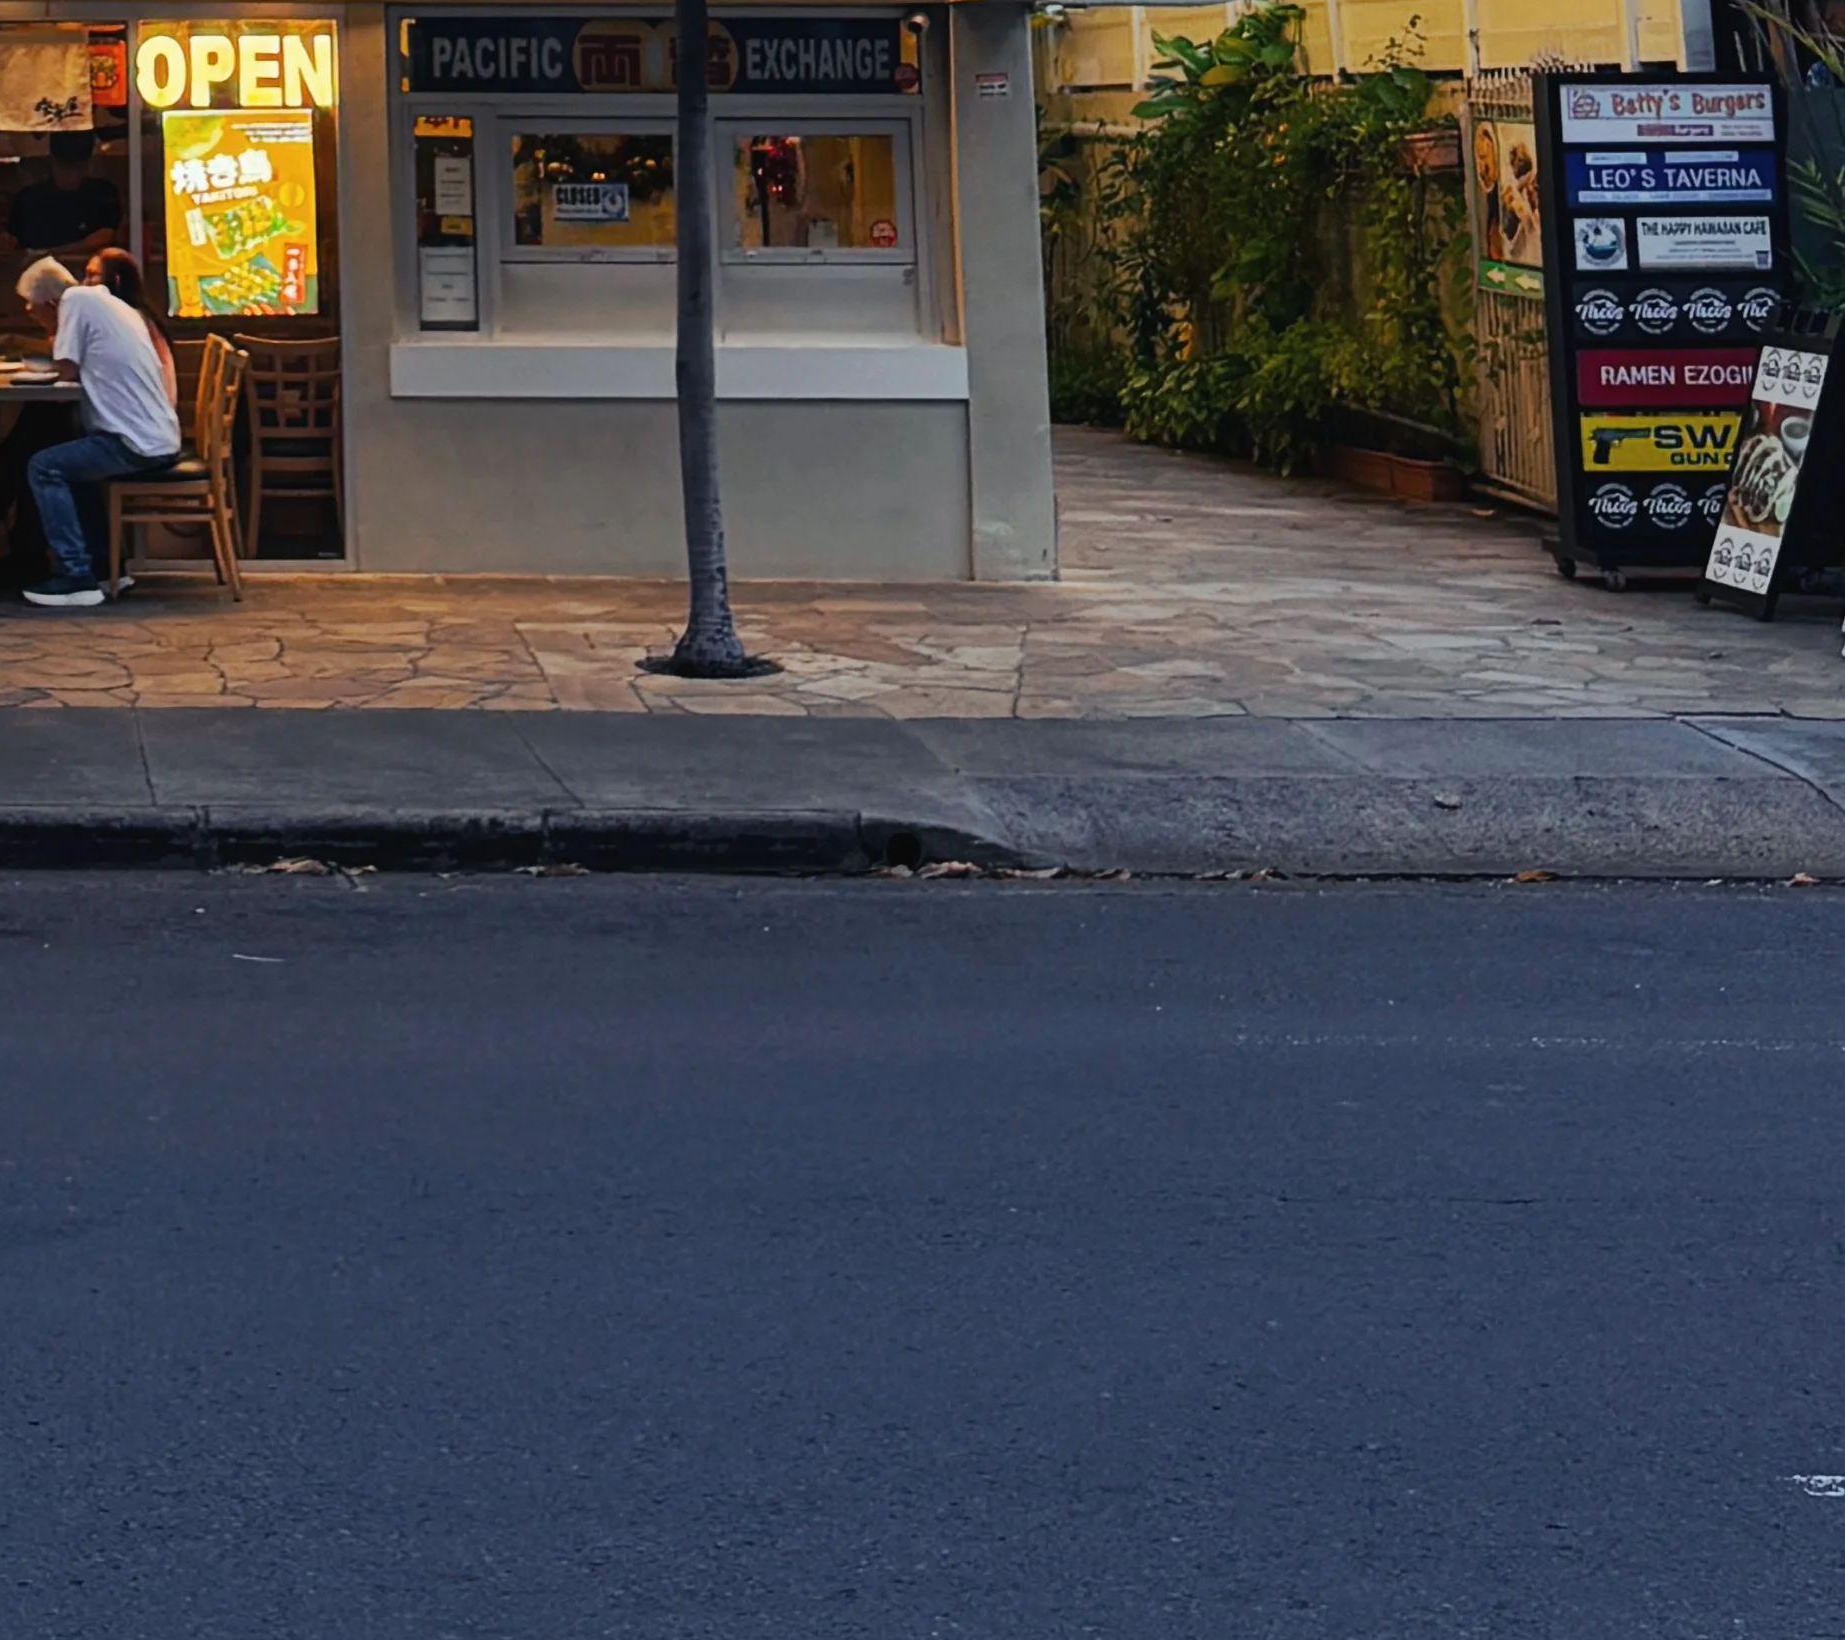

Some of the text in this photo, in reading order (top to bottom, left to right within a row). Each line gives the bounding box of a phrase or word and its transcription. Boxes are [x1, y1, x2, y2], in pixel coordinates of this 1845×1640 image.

[136, 35, 334, 108] OPEN
[432, 37, 563, 79] PACIFIC
[746, 38, 891, 80] EXCHANGE
[1691, 93, 1766, 118] Burgers
[1664, 168, 1762, 188] TAVERNA
[1601, 366, 1675, 385] RAMEN
